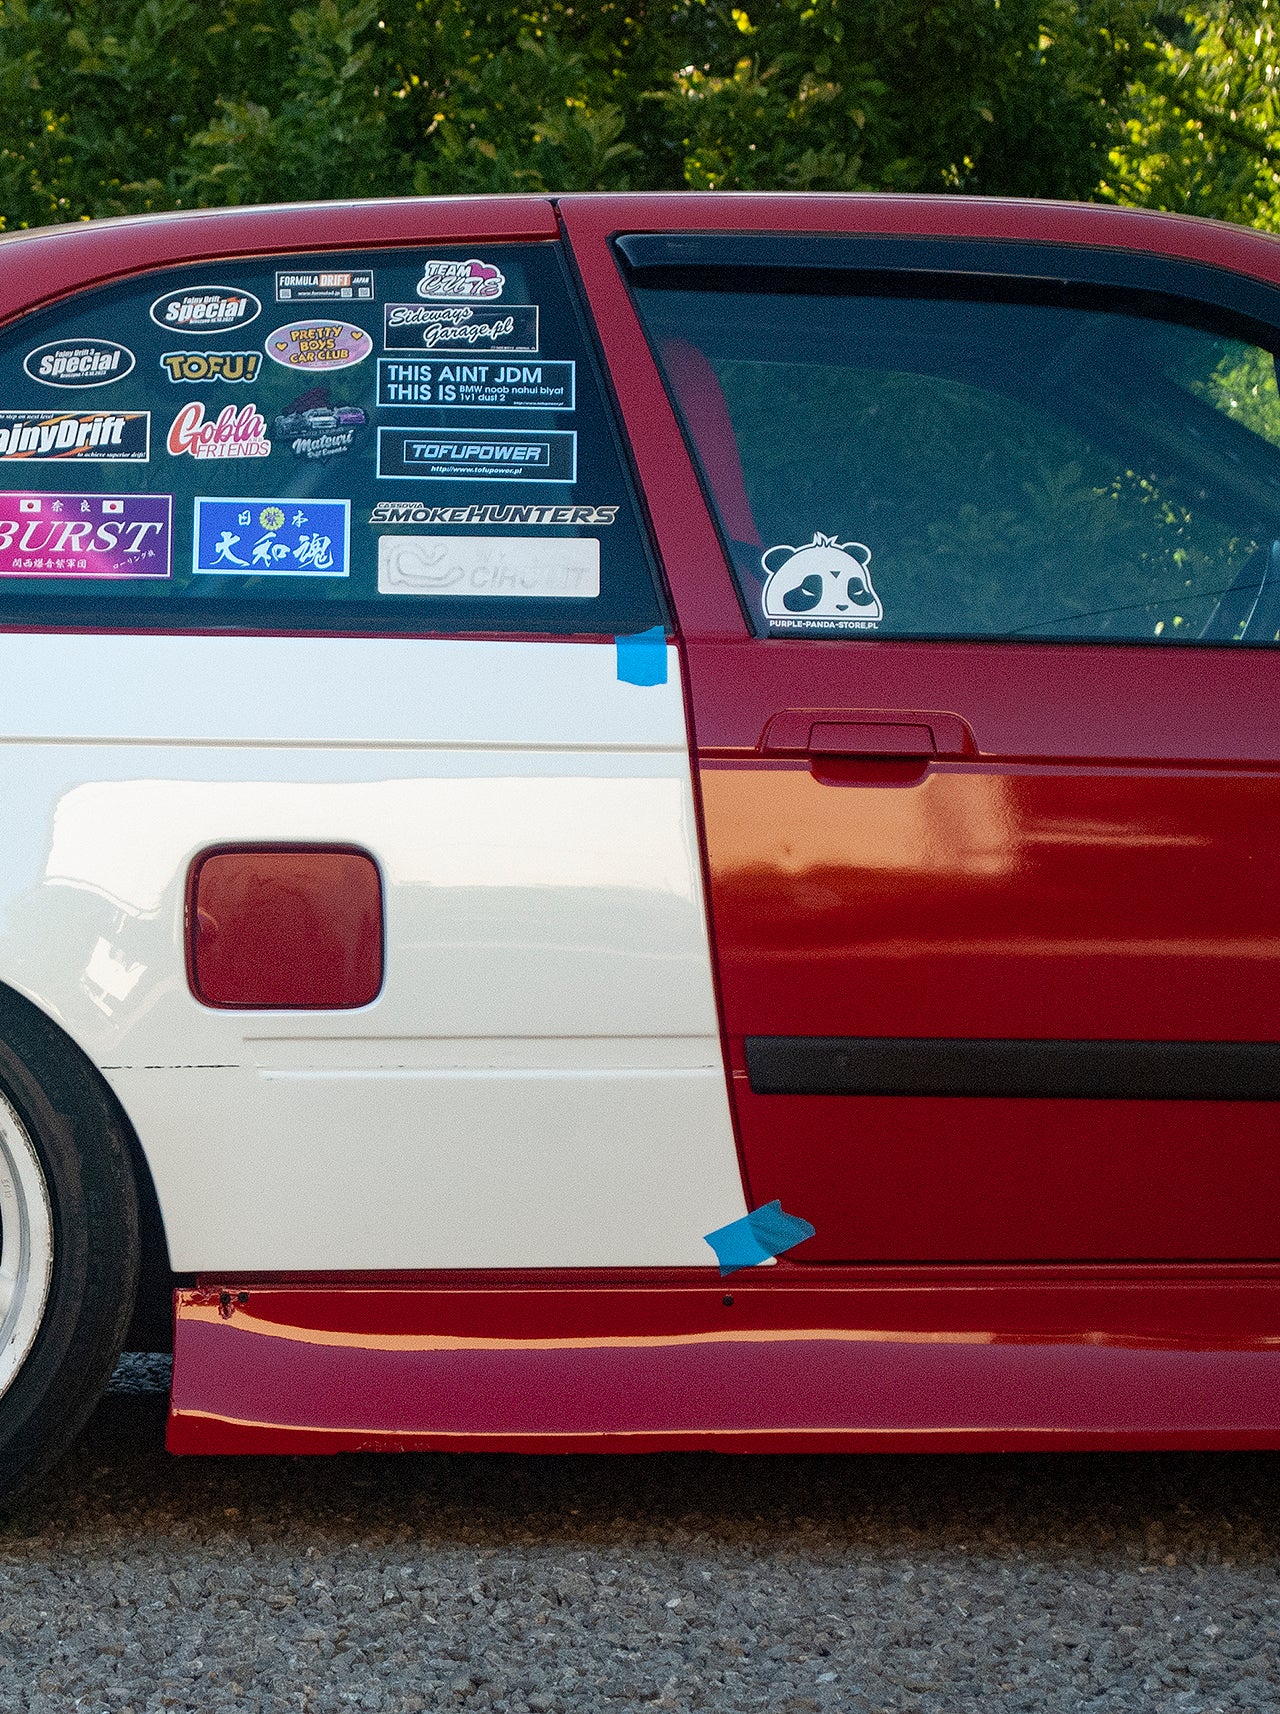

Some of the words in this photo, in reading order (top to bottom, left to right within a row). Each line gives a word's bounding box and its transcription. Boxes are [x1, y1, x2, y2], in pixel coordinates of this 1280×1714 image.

[428, 263, 471, 278] TEAM
[279, 276, 319, 286] FORMULA
[320, 274, 348, 286] DRIFT
[420, 275, 503, 297] CUTE
[165, 299, 247, 322] Special
[391, 308, 472, 323] Sideways
[290, 327, 342, 341] PRETTY
[424, 318, 513, 347] Garage.pl
[300, 339, 334, 351] BOYS
[39, 351, 121, 375] Special
[290, 353, 315, 363] CAR
[317, 350, 349, 360] CLUB
[166, 356, 257, 379] TOFU!
[388, 365, 432, 381] THIS
[438, 366, 489, 382] AINT
[494, 367, 542, 383] JDM
[388, 384, 432, 401] THIS
[438, 385, 457, 401] IS
[460, 385, 482, 393] BMW
[485, 386, 509, 394] noob
[461, 393, 475, 401] 1v1
[169, 404, 263, 454] Gobla
[196, 442, 269, 458] FRIENDS
[412, 445, 542, 461] TOFUPOWER
[371, 506, 618, 523] SMOKEHUNTERS
[209, 531, 334, 569] 大和魂
[769, 620, 879, 629] PURPLE-PANDA-STORE.PL
